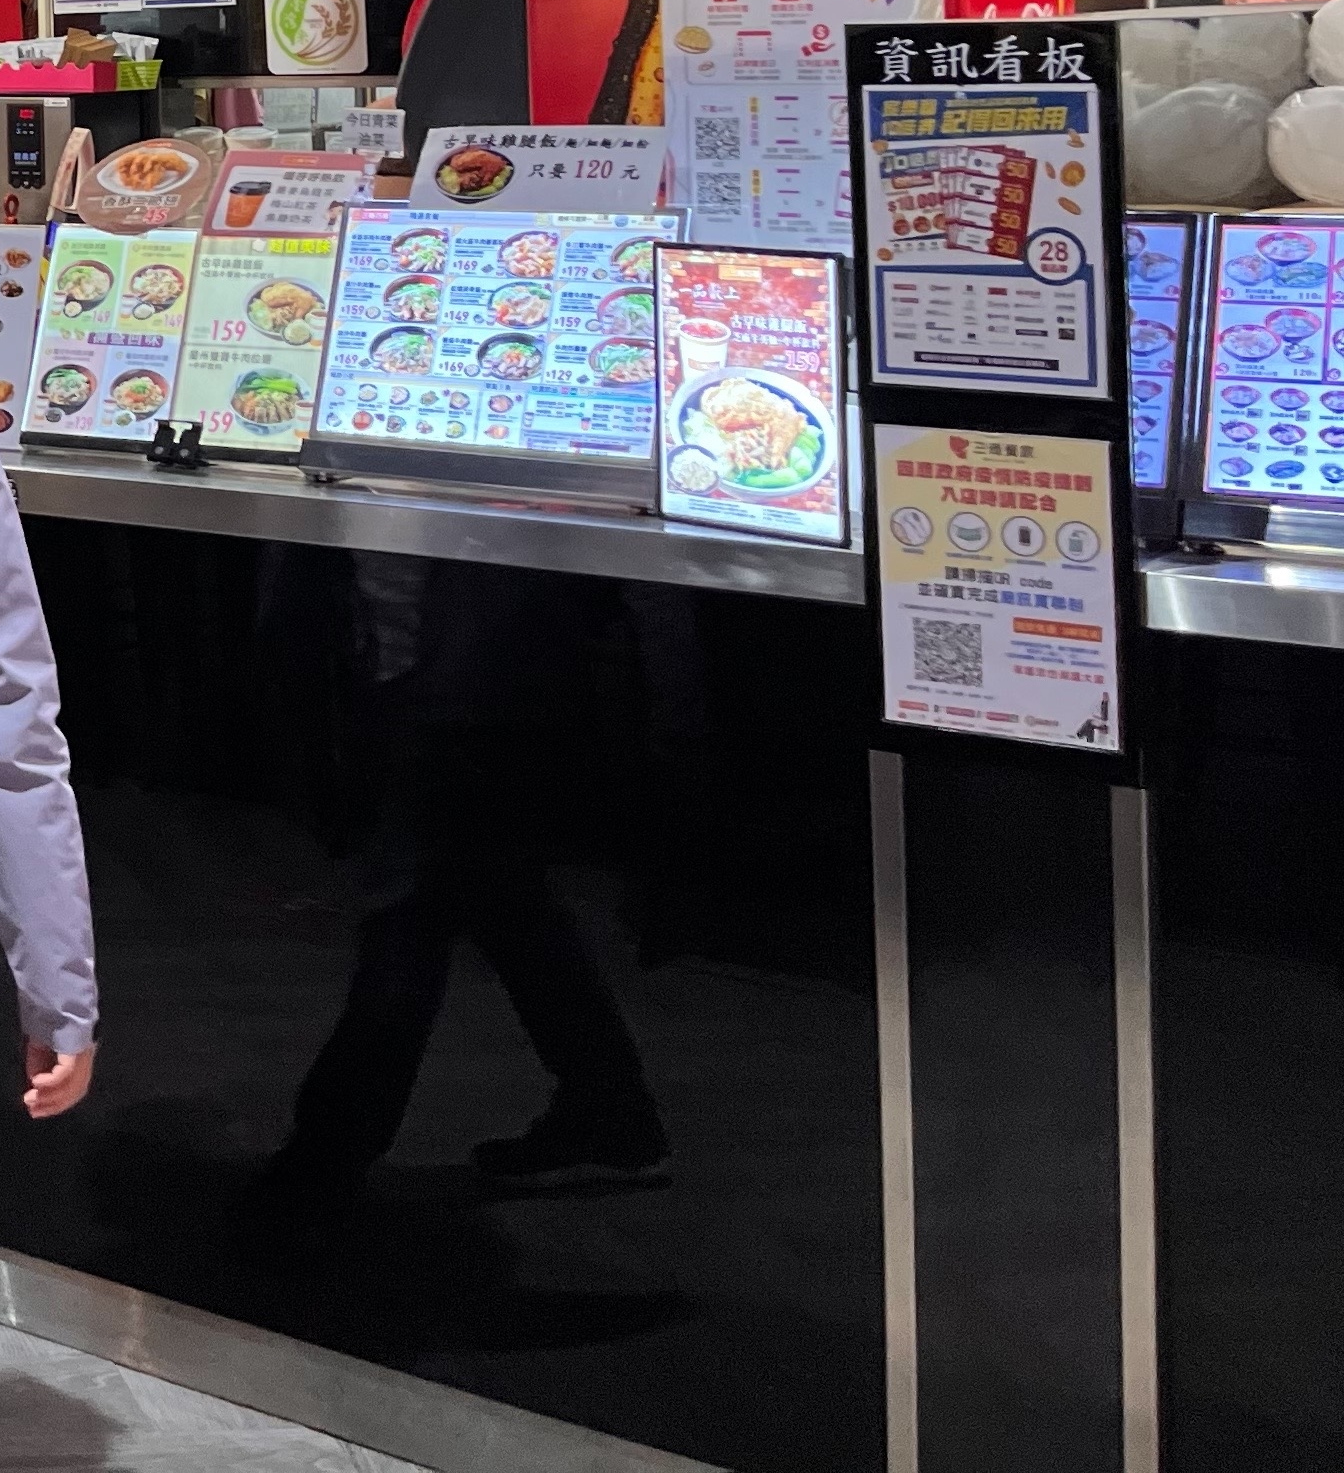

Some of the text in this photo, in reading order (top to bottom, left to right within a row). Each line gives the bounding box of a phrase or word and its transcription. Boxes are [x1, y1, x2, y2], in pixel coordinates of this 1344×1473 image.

[874, 35, 1093, 83] 資訊看板
[574, 159, 614, 179] 120
[621, 164, 640, 179] 元
[1039, 240, 1069, 261] 28
[211, 320, 247, 342] 159
[785, 349, 821, 373] 159
